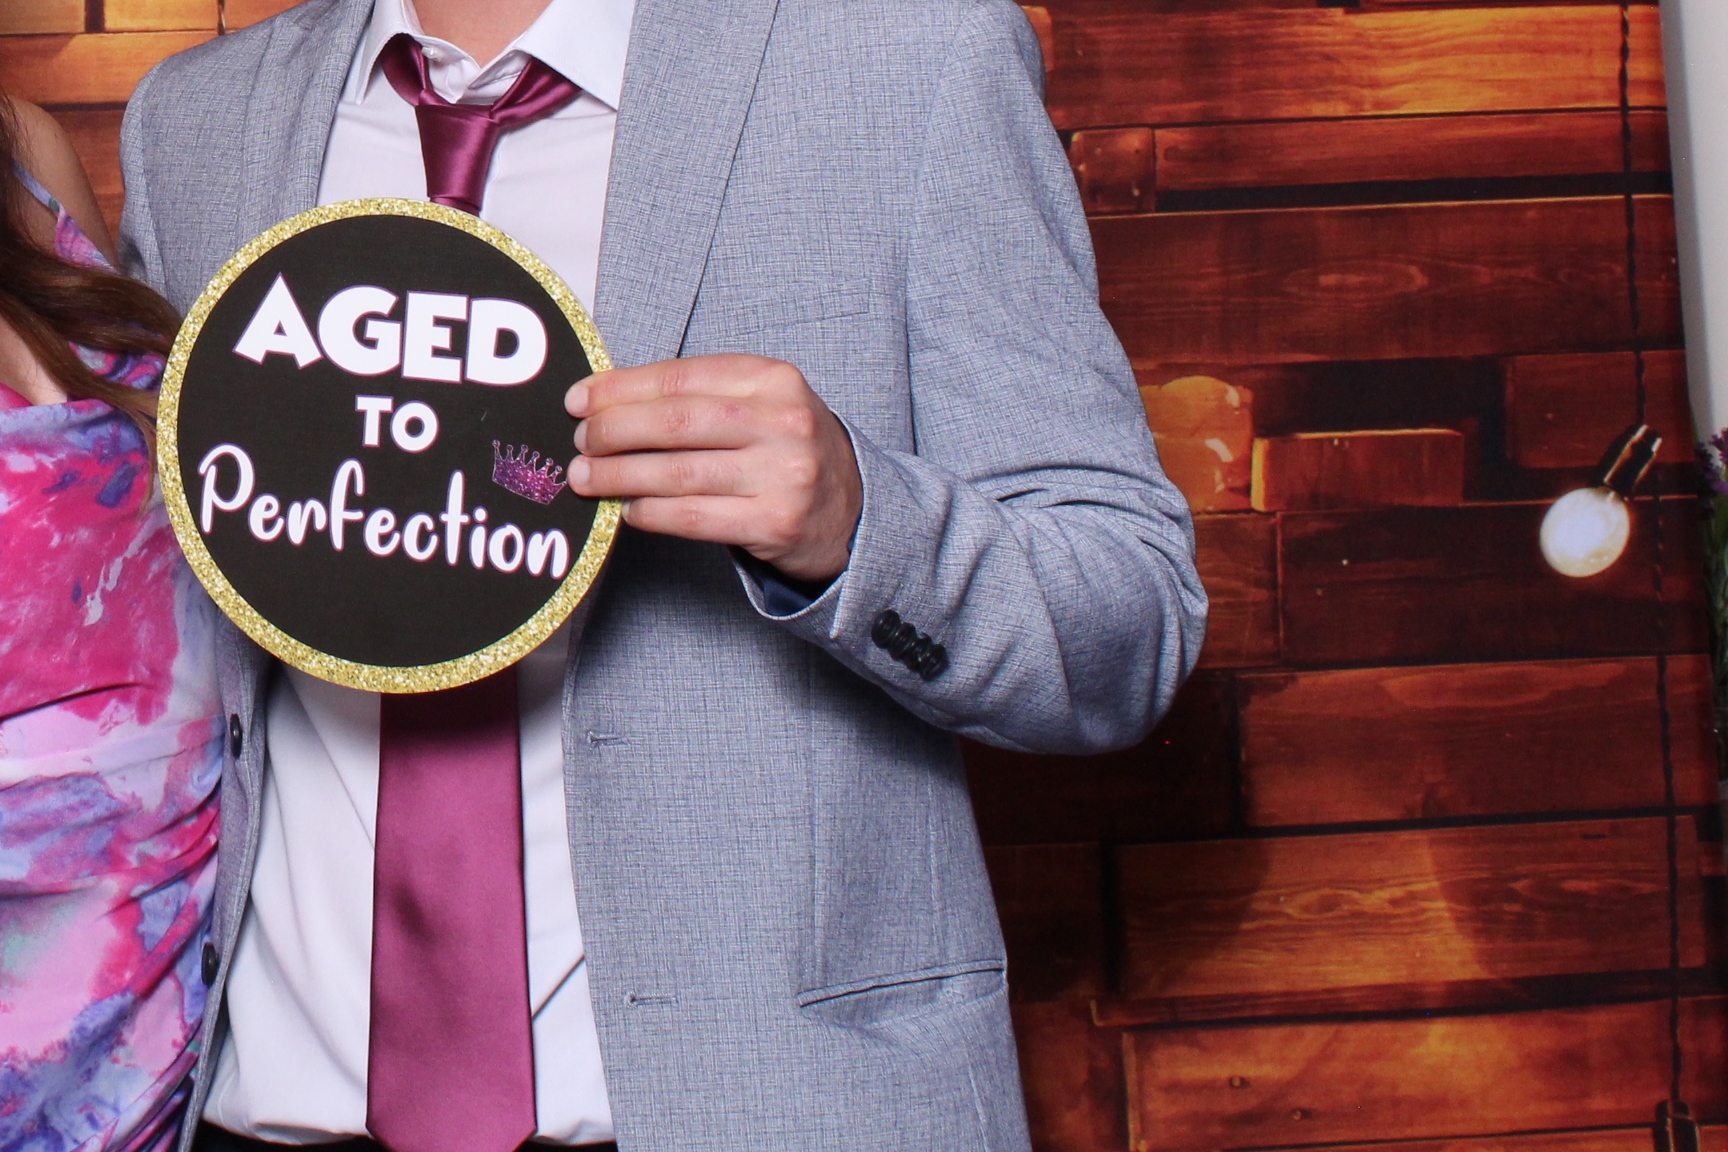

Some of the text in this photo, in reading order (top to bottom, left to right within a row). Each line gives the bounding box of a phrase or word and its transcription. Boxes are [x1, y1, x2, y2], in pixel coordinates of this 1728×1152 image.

[232, 272, 548, 387] AGED
[355, 394, 439, 453] TO
[198, 443, 570, 580] Perfection
